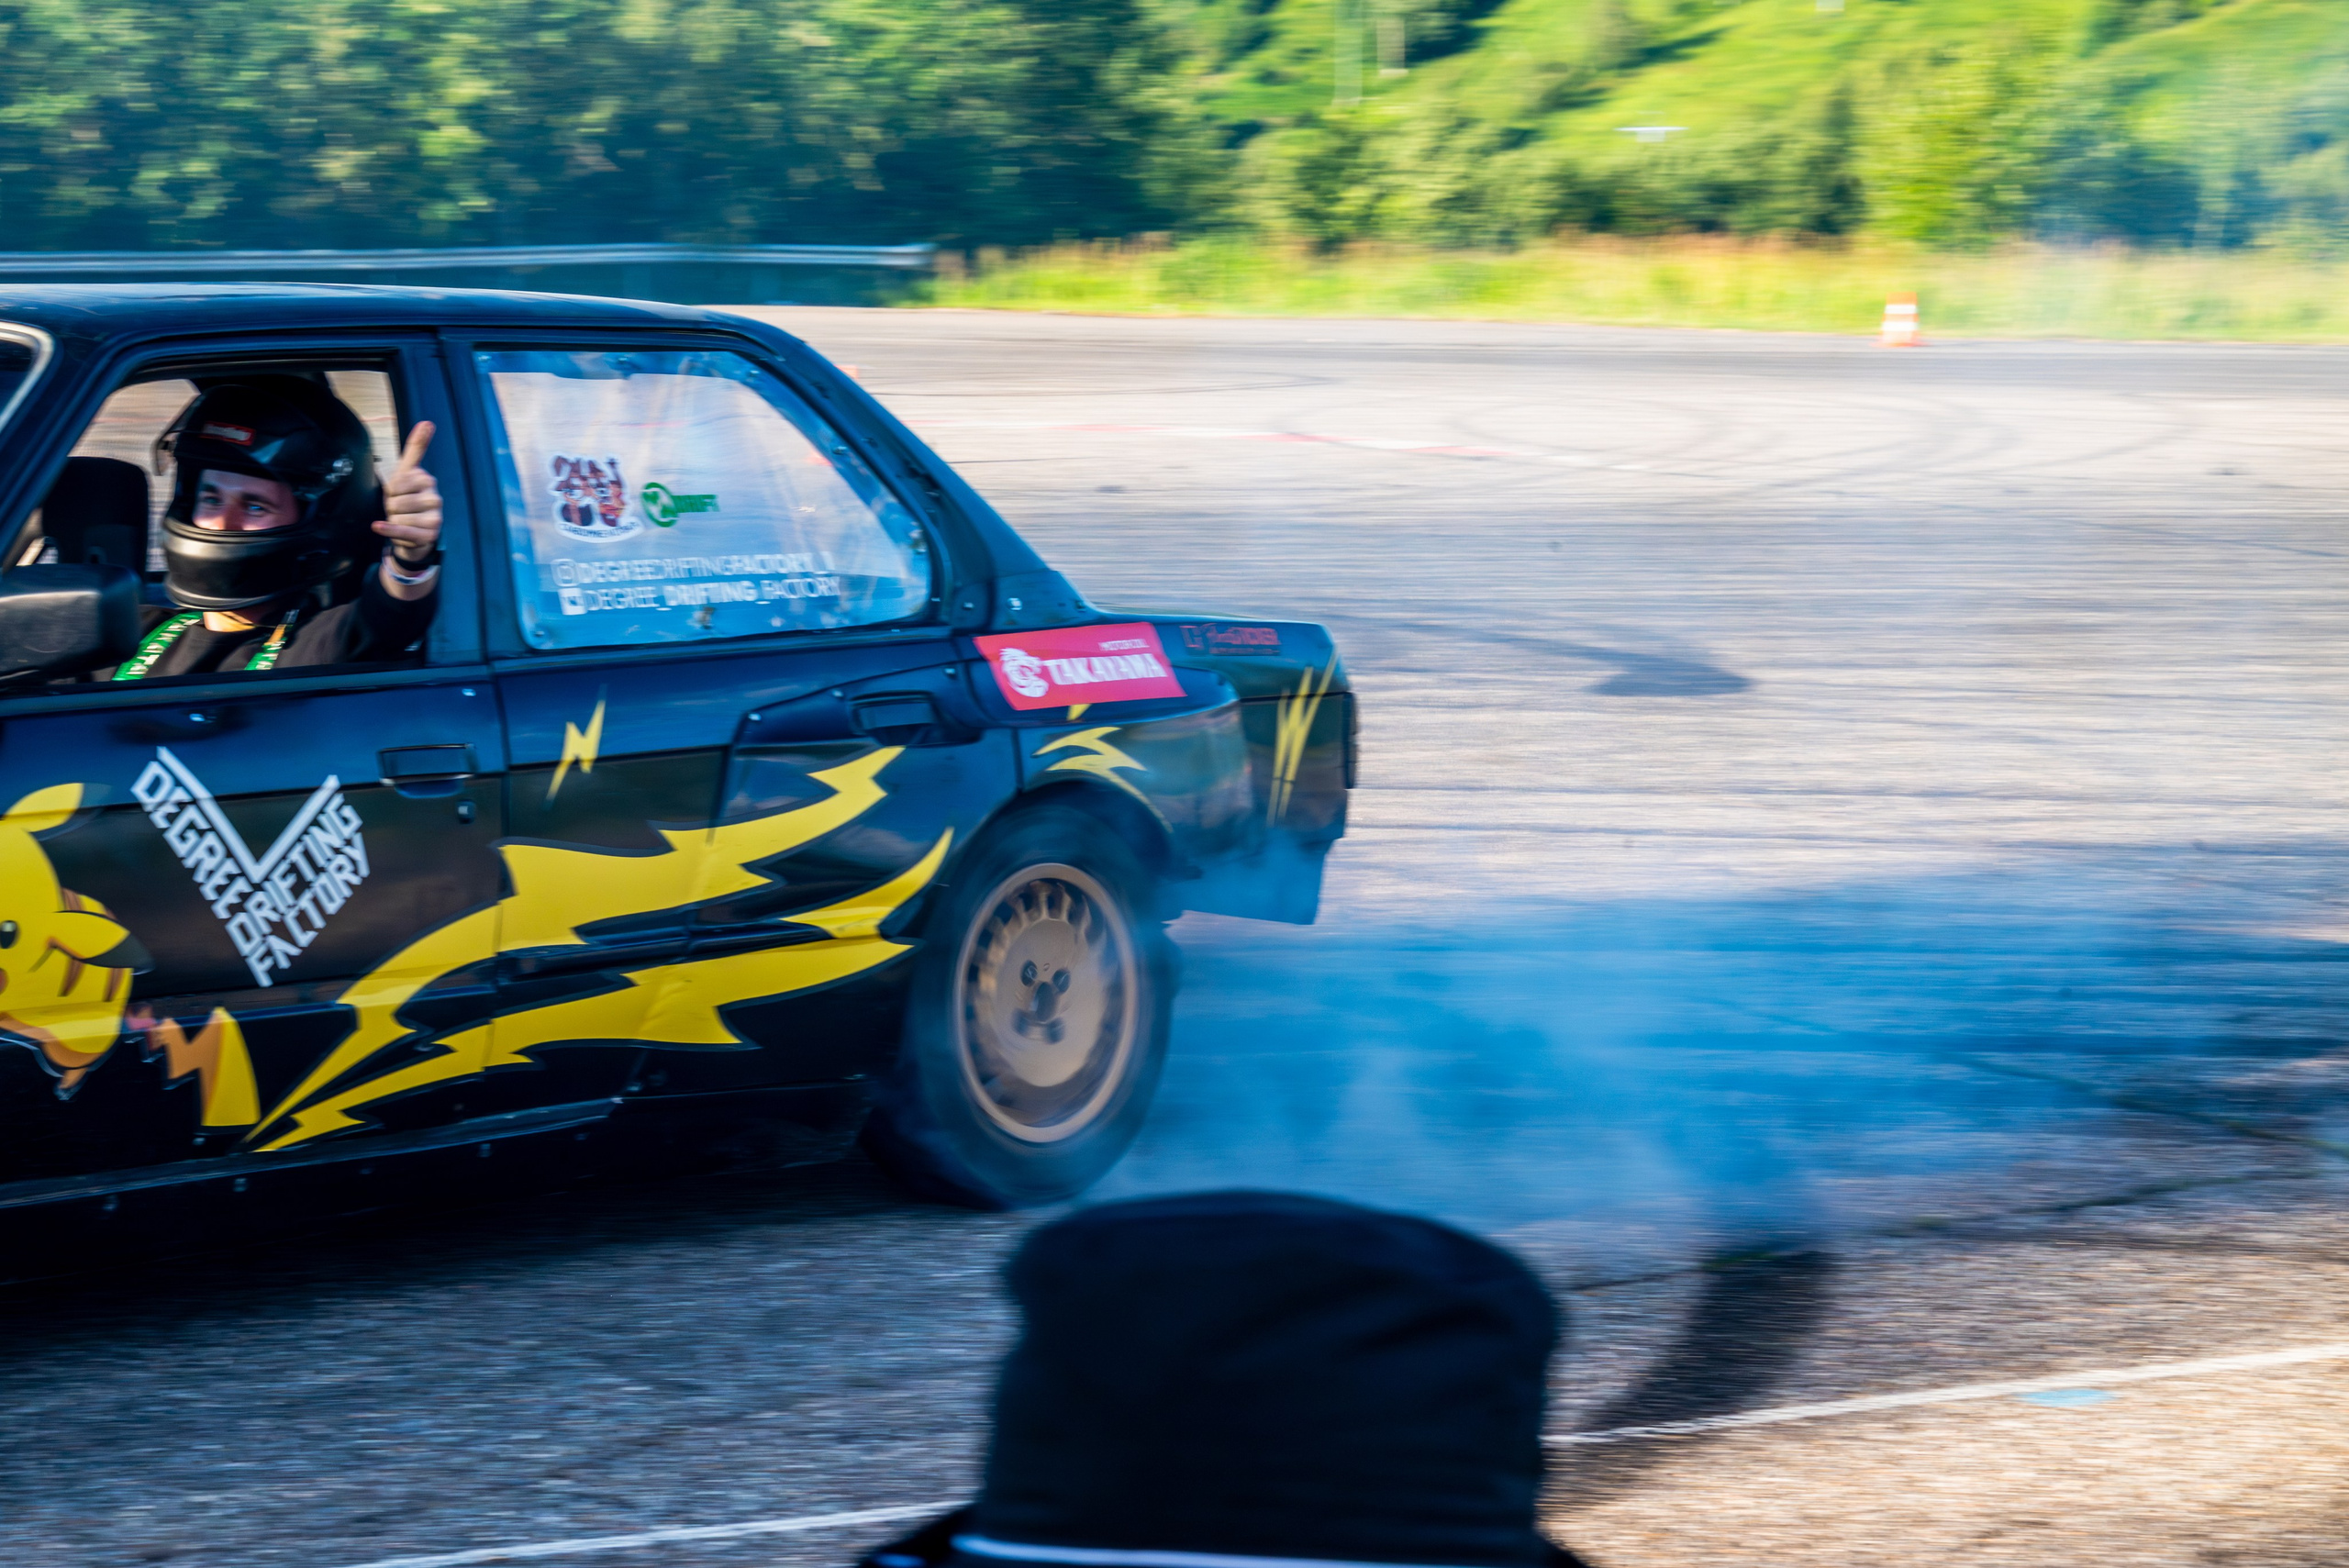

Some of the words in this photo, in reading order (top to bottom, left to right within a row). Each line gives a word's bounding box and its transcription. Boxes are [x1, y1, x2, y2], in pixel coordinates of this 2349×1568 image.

[130, 761, 253, 918] DEGREE
[225, 793, 362, 956] DRIFTING
[245, 832, 370, 987] FACTORY
